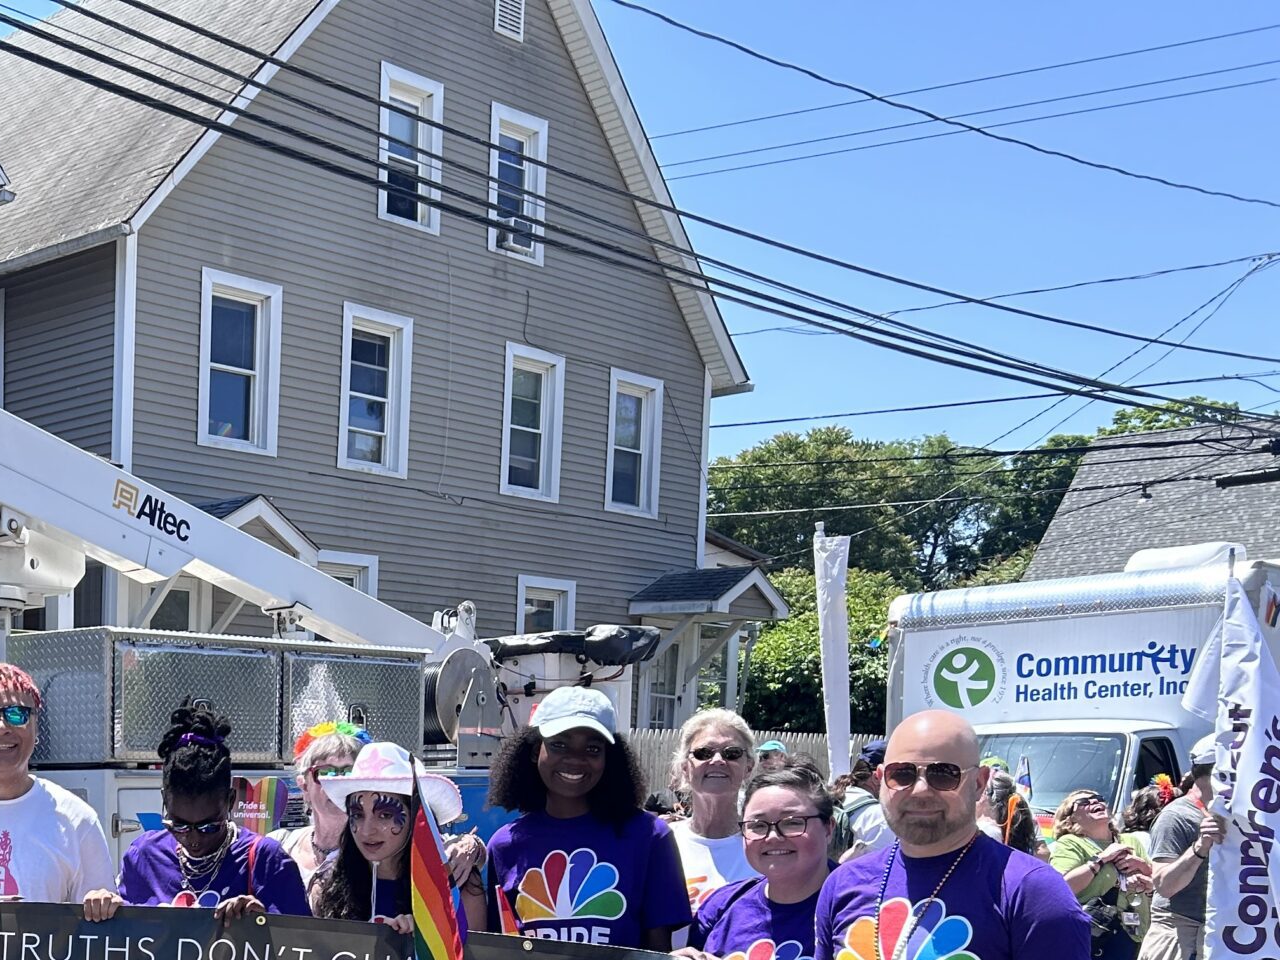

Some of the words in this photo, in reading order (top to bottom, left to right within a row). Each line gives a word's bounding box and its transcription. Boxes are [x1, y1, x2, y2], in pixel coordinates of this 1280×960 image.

[136, 494, 191, 542] Altec
[929, 650, 939, 662] care
[1015, 682, 1078, 702] Health
[1084, 680, 1154, 699] Center,
[238, 801, 258, 809] Pride
[259, 801, 266, 809] is
[233, 811, 271, 819] universal.
[524, 926, 611, 946] IDE
